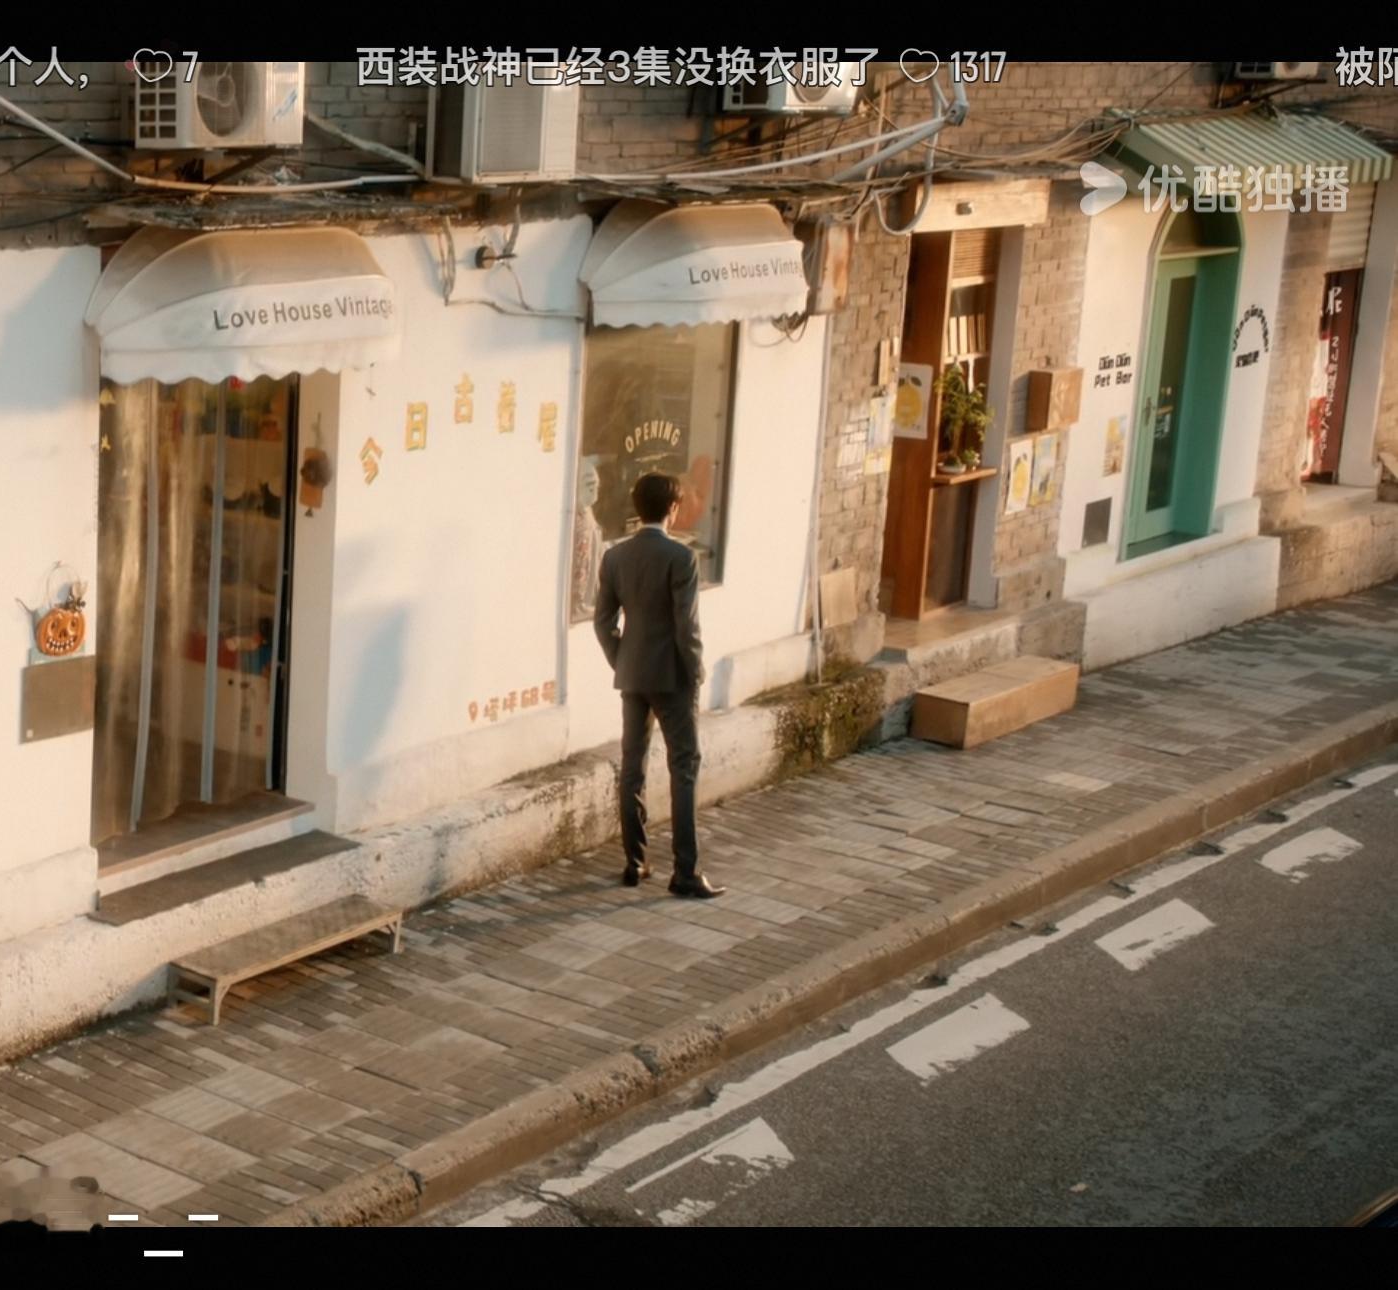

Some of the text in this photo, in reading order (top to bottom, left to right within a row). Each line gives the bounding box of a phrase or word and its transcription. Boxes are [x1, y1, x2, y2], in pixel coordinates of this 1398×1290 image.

[688, 265, 728, 285] Love
[730, 261, 769, 279] House
[213, 308, 269, 331] Love
[272, 301, 333, 324] House
[1093, 370, 1132, 388] Pet Bar
[625, 420, 681, 453] OPENING
